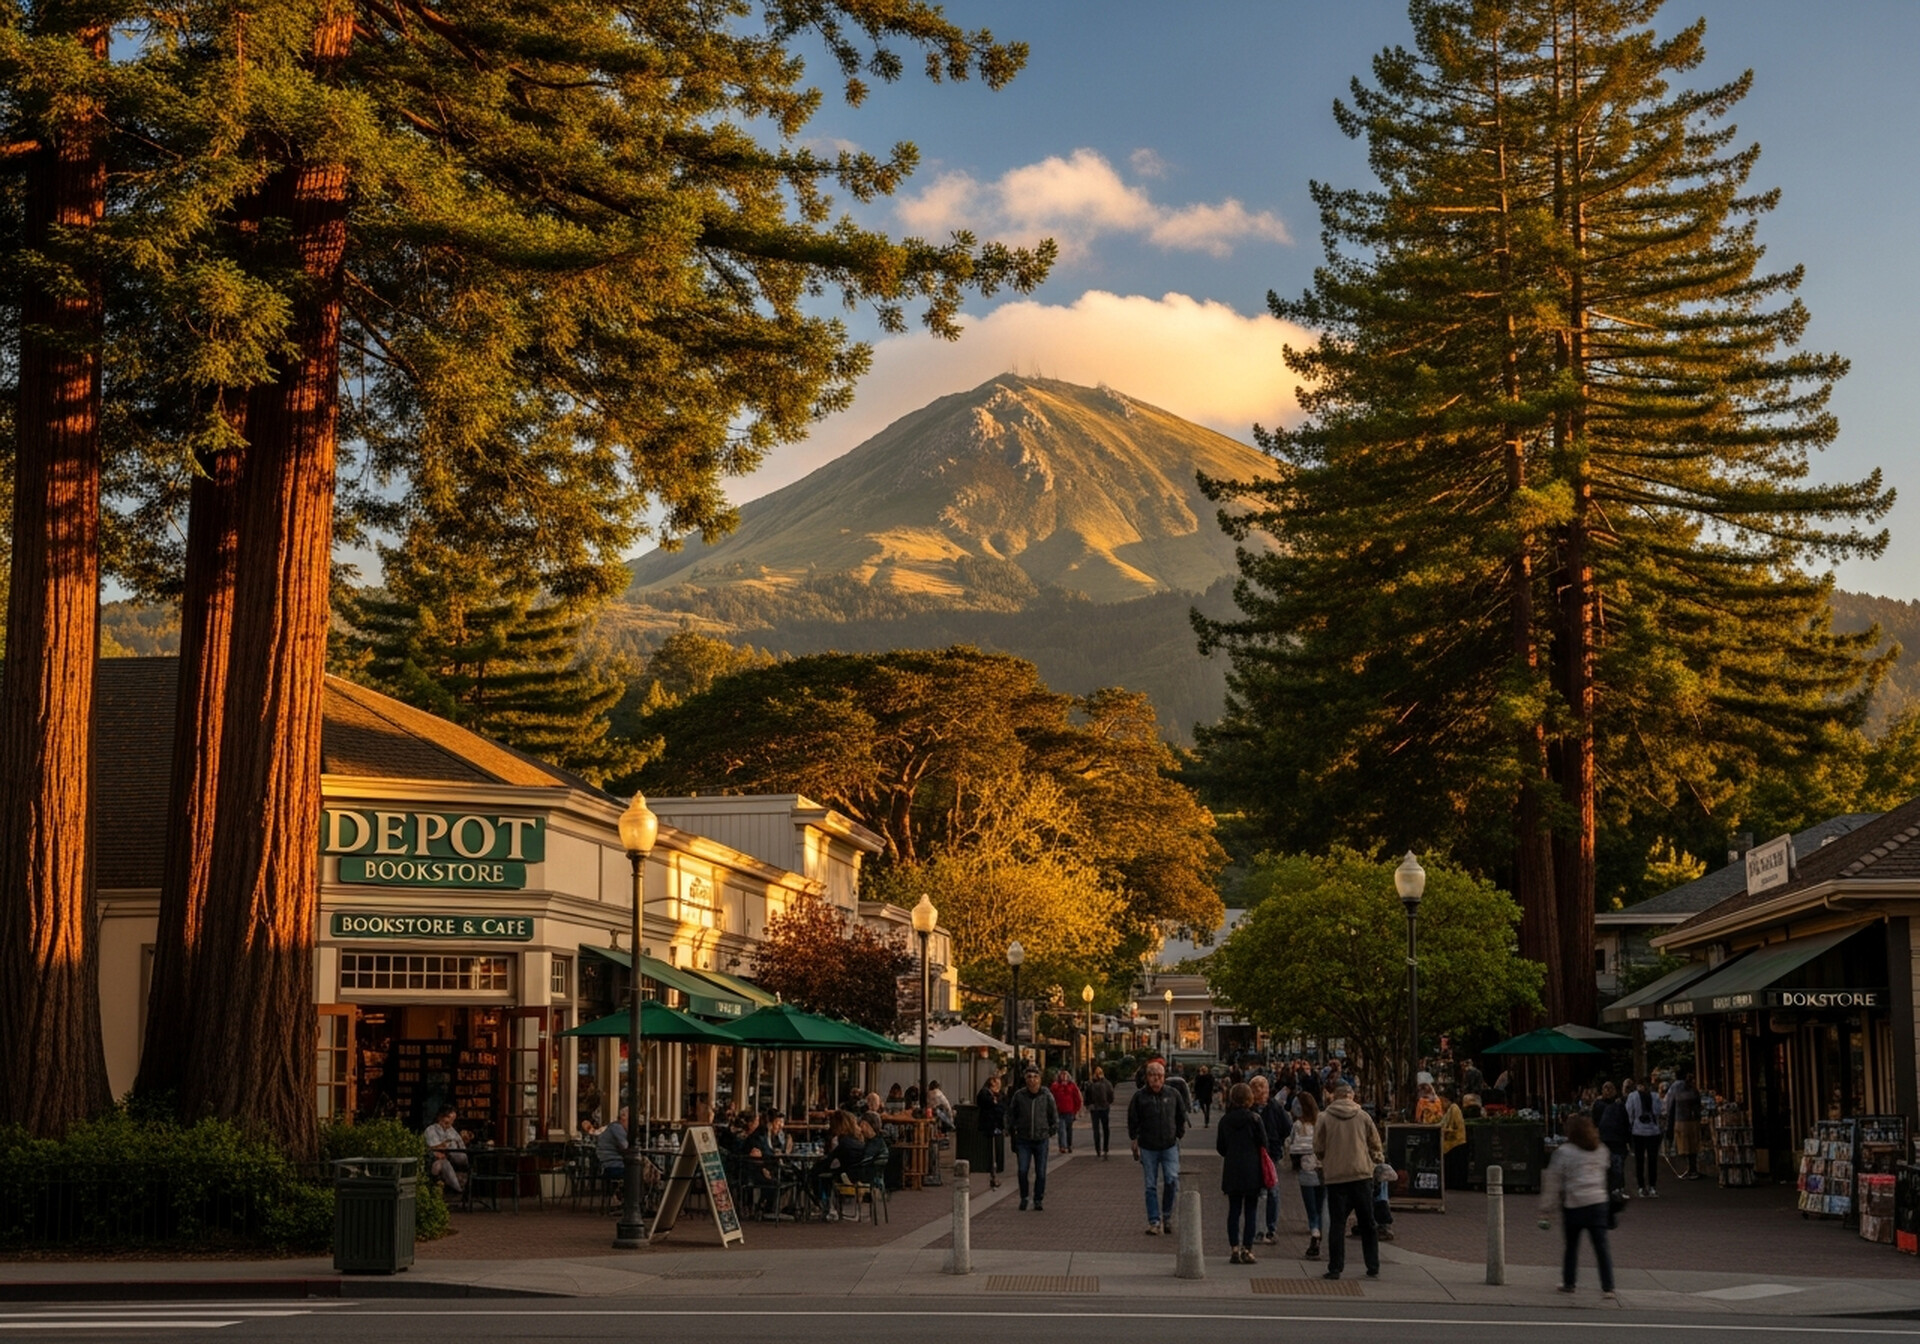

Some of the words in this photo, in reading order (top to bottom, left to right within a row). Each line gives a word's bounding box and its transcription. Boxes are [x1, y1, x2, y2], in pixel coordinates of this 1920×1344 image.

[325, 809, 536, 859] DEPOT
[365, 860, 505, 882] BOOKSTORE
[342, 917, 455, 934] BOOKSTORE
[463, 919, 475, 934] &
[481, 919, 526, 935] CAFE
